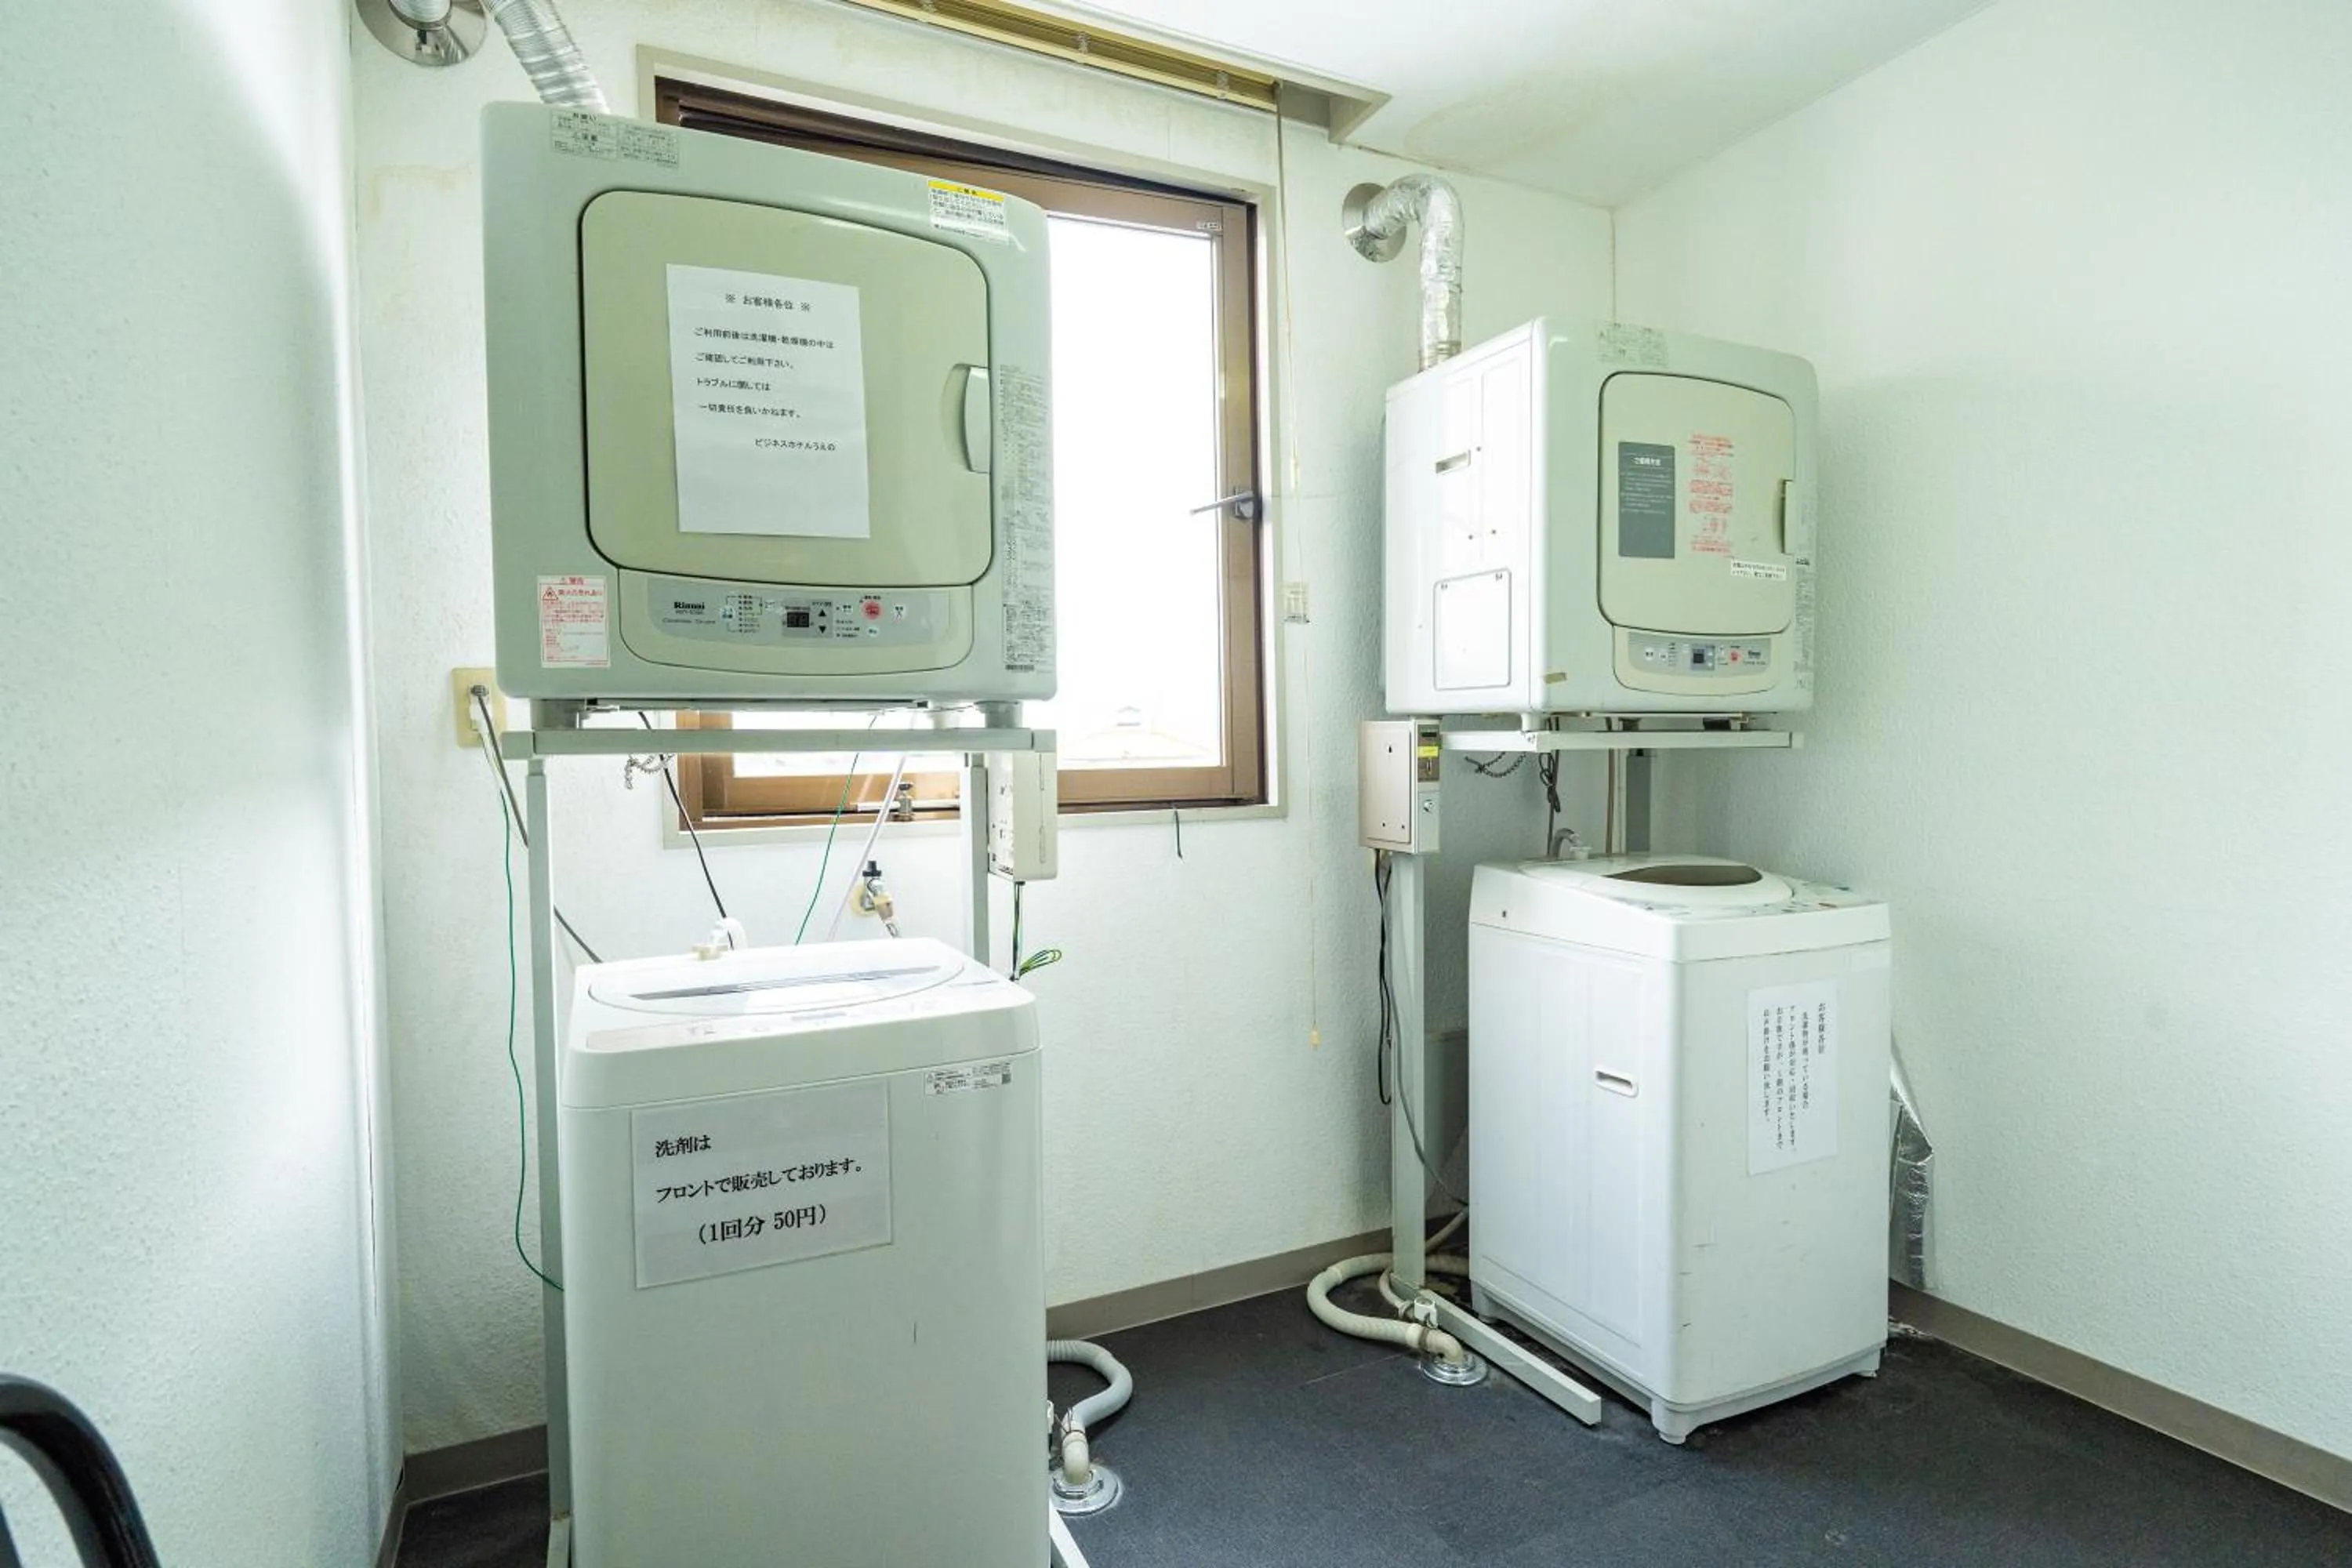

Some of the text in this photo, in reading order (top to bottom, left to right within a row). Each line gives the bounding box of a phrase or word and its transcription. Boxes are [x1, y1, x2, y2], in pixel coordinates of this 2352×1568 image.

[742, 295, 794, 310] お客様各位
[695, 352, 794, 369] ご確認してご利用下さい。
[697, 377, 771, 391] トラブルに関しては
[699, 404, 800, 418] 一切責任を負いかねます。
[754, 438, 836, 452] ビジネスホテルうえの
[655, 1134, 711, 1158] 洗剤は
[656, 1157, 863, 1203] フロントで販売しております。
